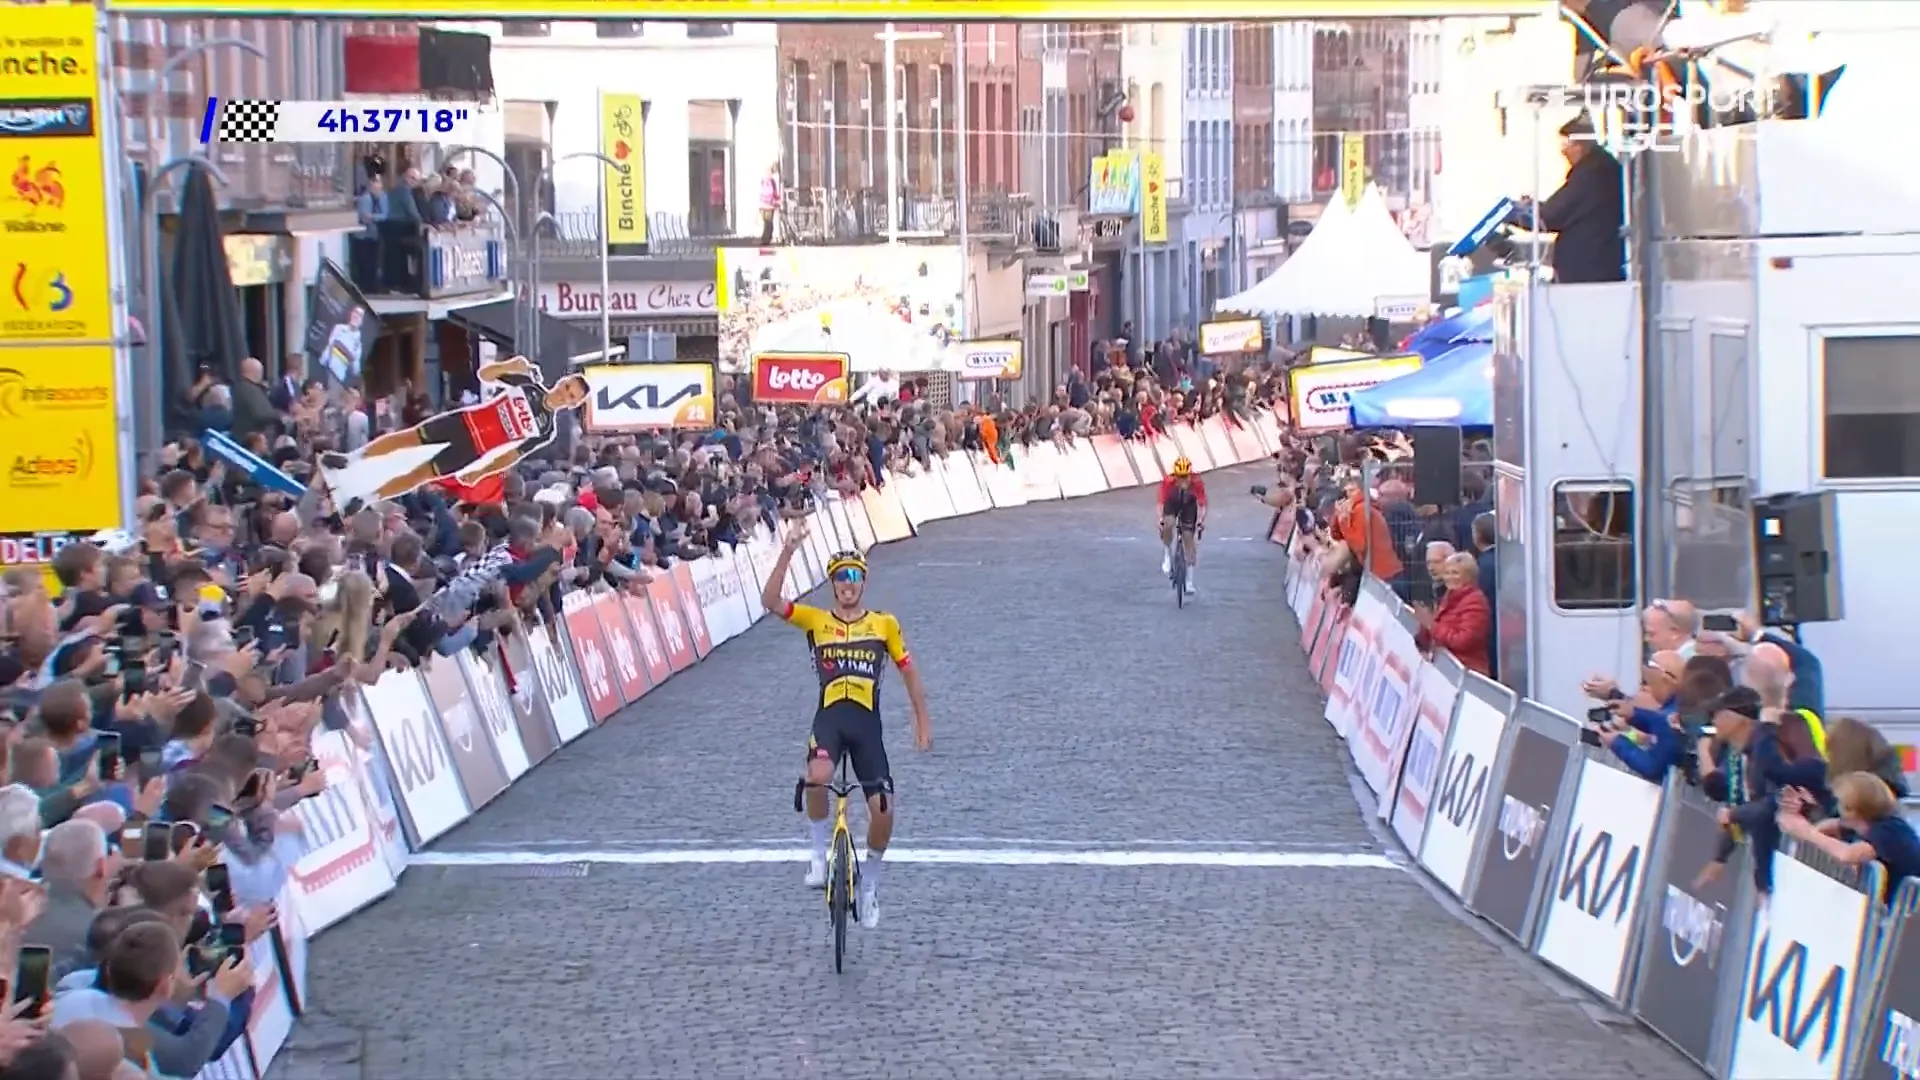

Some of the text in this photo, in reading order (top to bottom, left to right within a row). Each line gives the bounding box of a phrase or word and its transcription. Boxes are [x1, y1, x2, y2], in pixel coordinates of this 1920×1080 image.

[618, 163, 634, 230] Binche
[557, 282, 637, 312] Burau
[648, 284, 691, 309] Chez
[822, 649, 876, 661] JUMBO
[837, 660, 874, 674] VISMA
